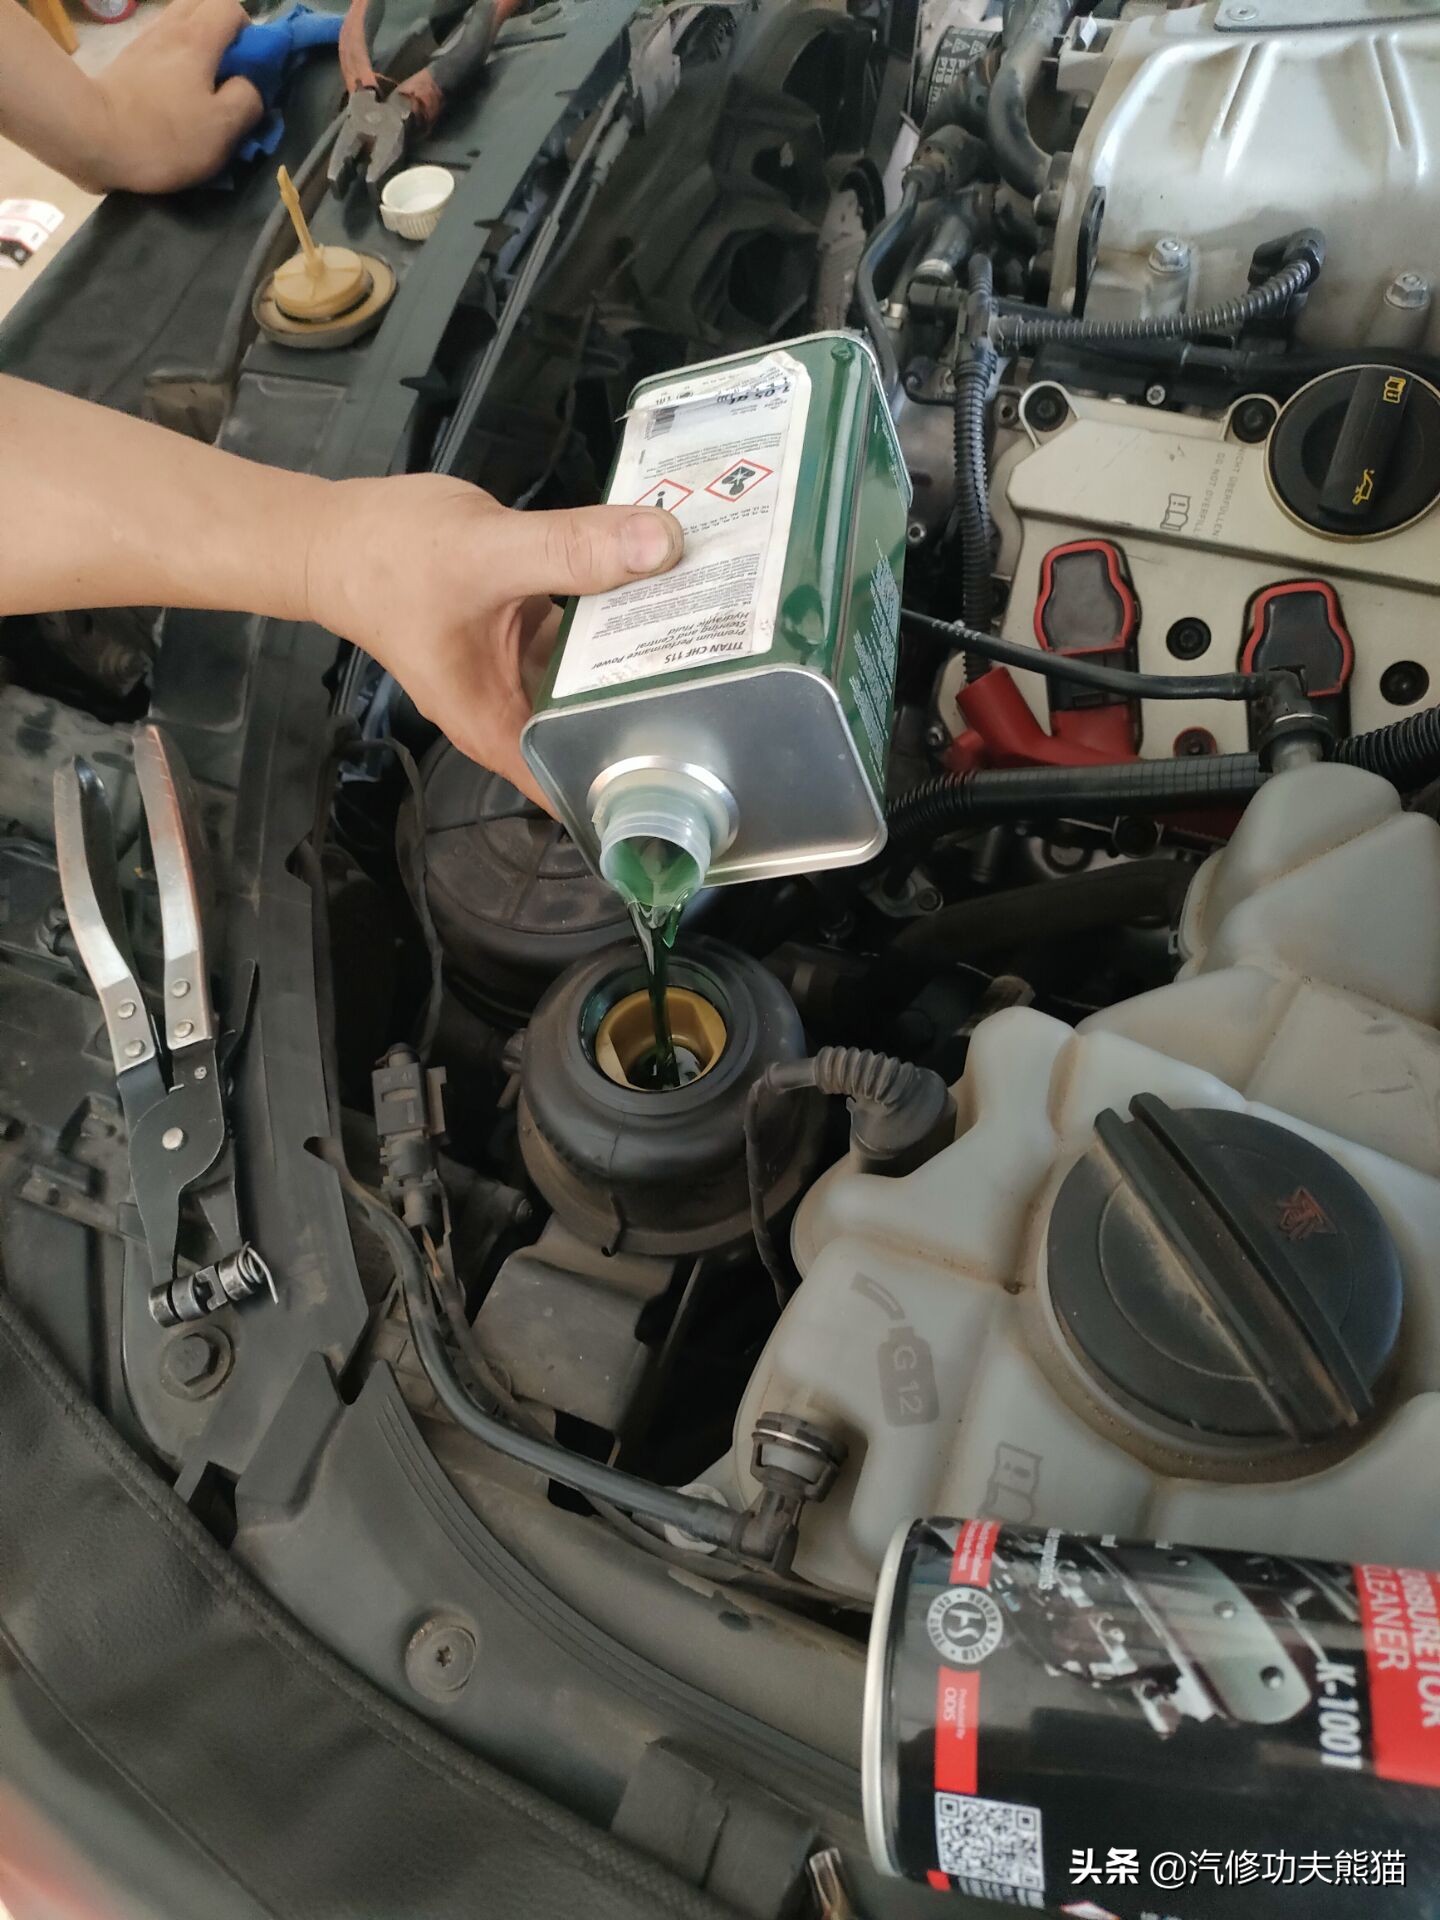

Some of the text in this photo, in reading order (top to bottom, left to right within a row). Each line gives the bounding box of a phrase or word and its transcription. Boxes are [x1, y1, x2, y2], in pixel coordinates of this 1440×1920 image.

[1208, 467, 1220, 487] NOT
[634, 619, 747, 651] Steering and Central
[666, 623, 696, 636] Fluid
[591, 629, 747, 670] Premium Performance Power
[664, 641, 743, 664] TITAN CHF 11S
[894, 1345, 923, 1417] G 12
[1362, 1564, 1411, 1671] CLEANER
[1315, 1660, 1363, 1771] K-1001
